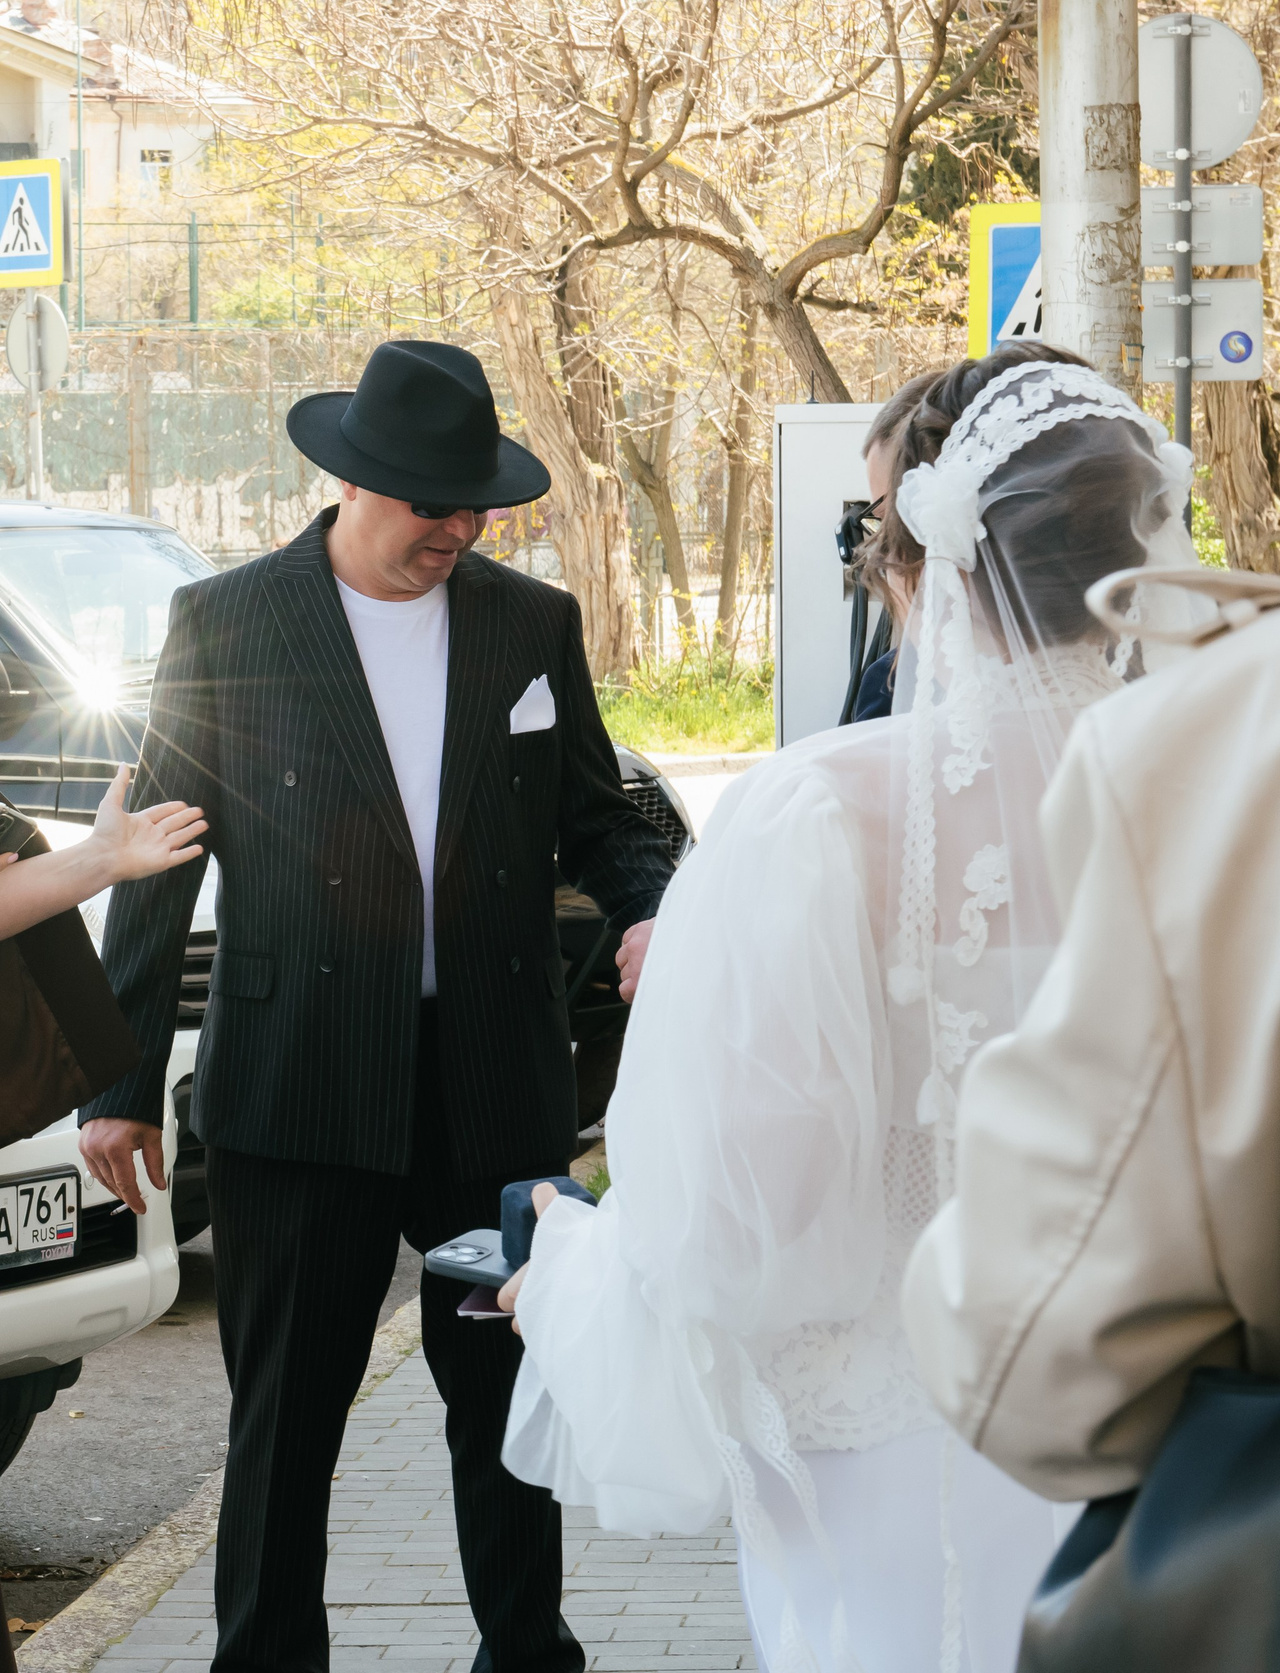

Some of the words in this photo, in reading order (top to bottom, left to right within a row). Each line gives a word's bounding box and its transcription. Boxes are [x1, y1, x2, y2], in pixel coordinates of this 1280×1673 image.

[19, 1182, 67, 1228] 761
[32, 1226, 56, 1243] RUS
[40, 1244, 74, 1260] TOYOTA
